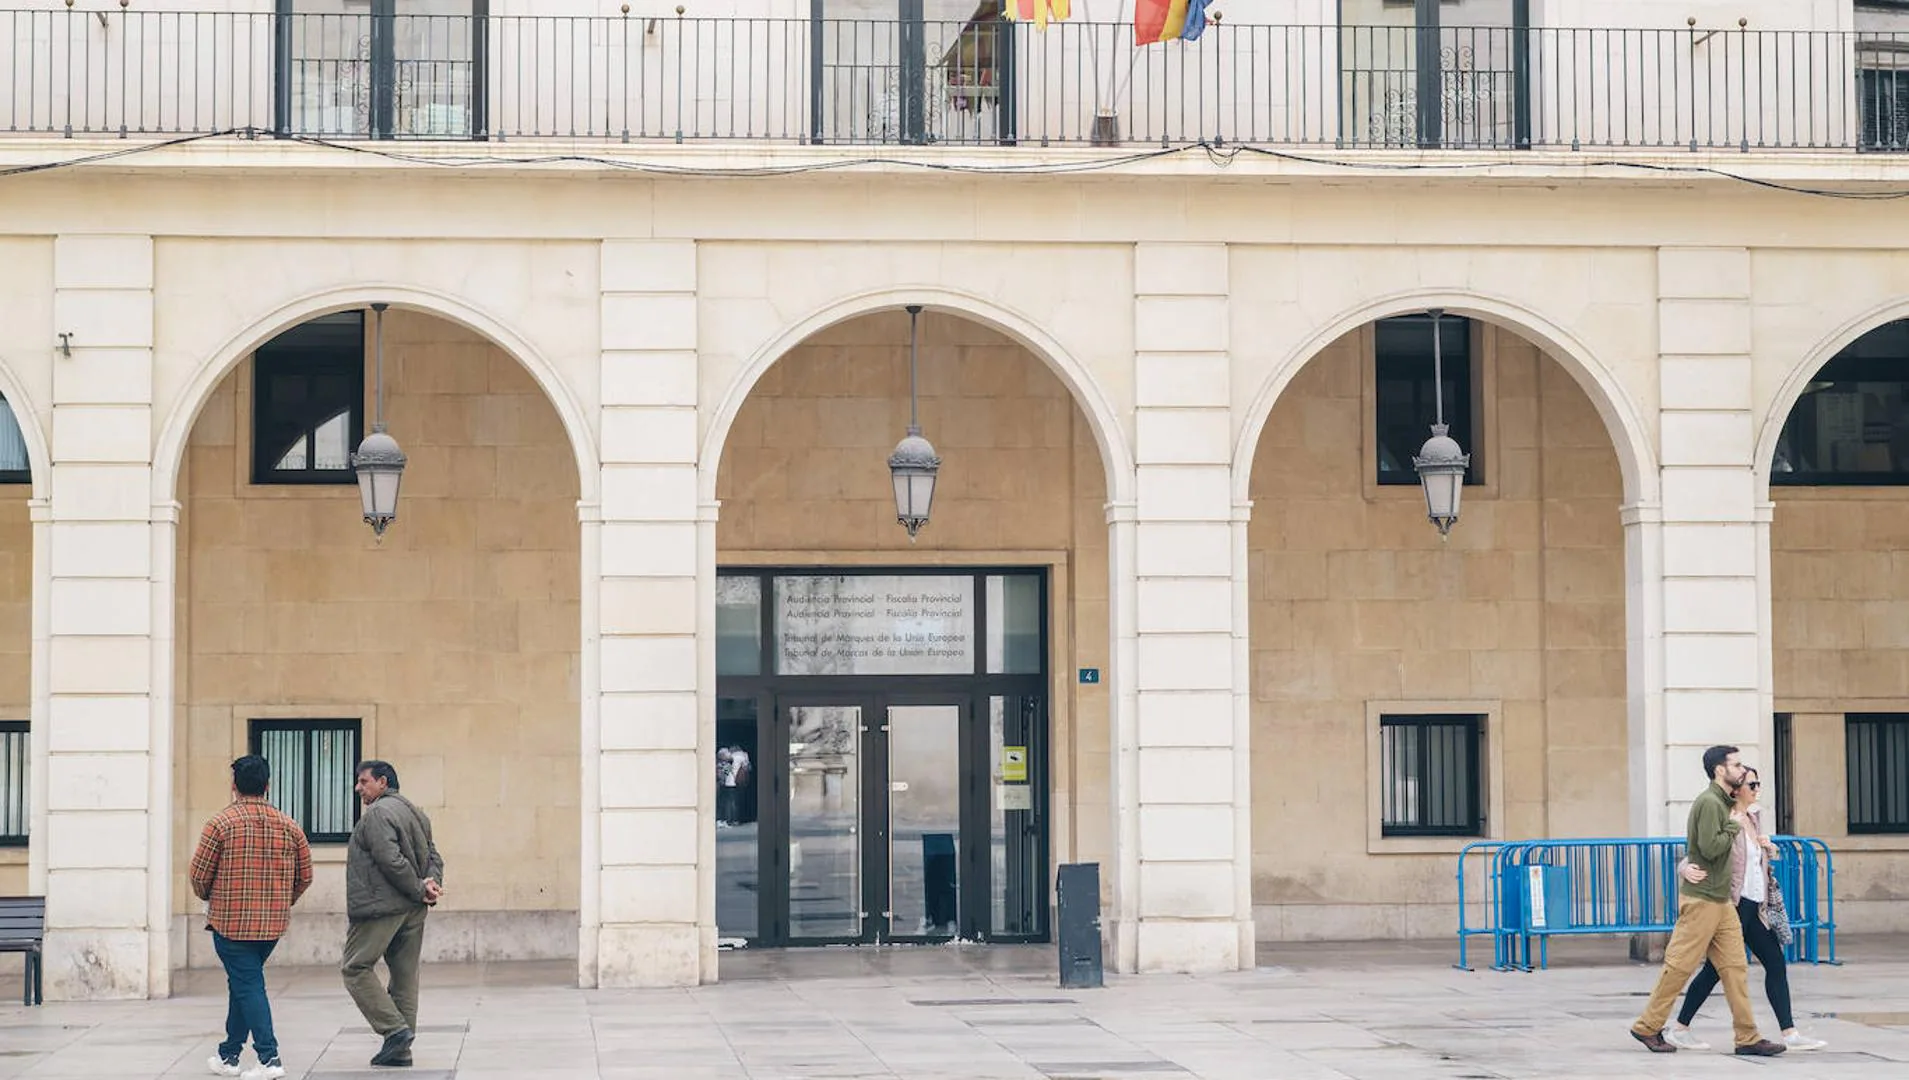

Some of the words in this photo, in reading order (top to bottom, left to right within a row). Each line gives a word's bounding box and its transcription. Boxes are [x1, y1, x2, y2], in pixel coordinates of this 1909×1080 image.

[821, 632, 833, 642] de
[878, 632, 890, 642] de
[821, 647, 833, 657] de
[872, 647, 884, 657] de
